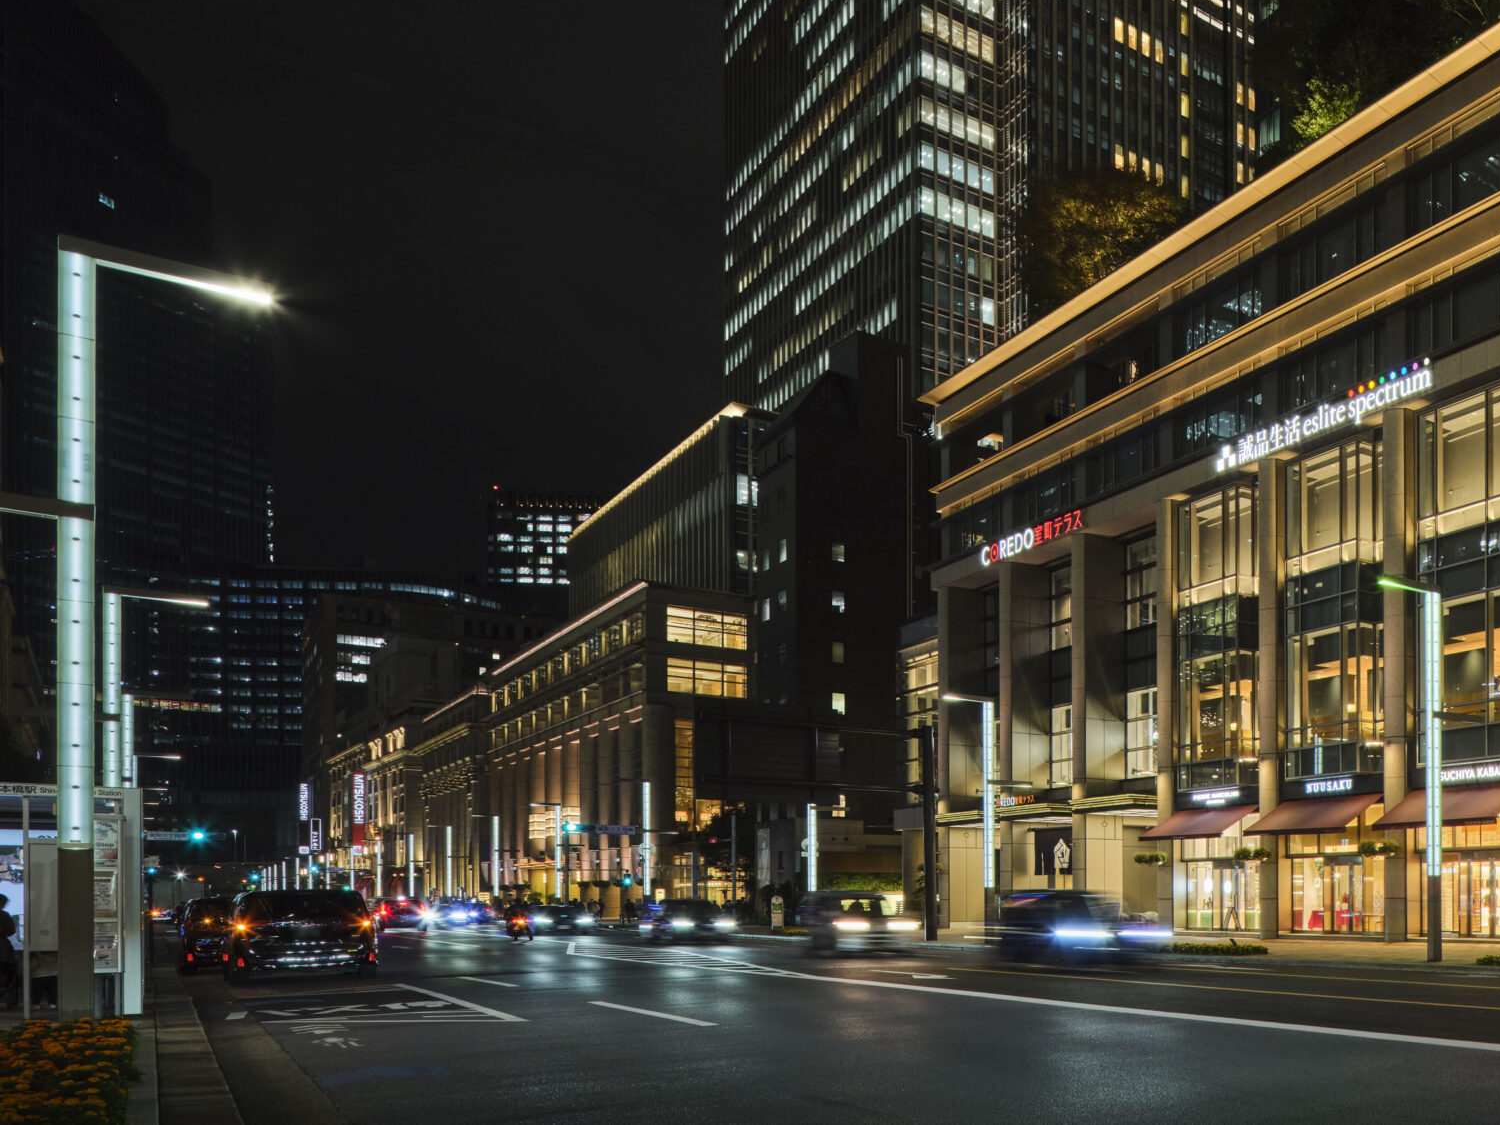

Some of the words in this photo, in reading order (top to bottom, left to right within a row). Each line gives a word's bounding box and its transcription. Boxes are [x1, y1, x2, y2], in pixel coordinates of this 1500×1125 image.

[1238, 415, 1300, 464] 誠品生活
[1303, 402, 1346, 436] eslite
[1347, 368, 1432, 424] spectrum
[980, 527, 1034, 566] COREDO
[1034, 509, 1083, 546] 室町テラス
[98, 789, 122, 797] Station
[1305, 778, 1353, 793] NOUSAKU
[1440, 768, 1475, 781] SUCHIYA
[299, 783, 309, 821] MITSUKOSHI
[353, 774, 365, 825] MITSUKOSHI
